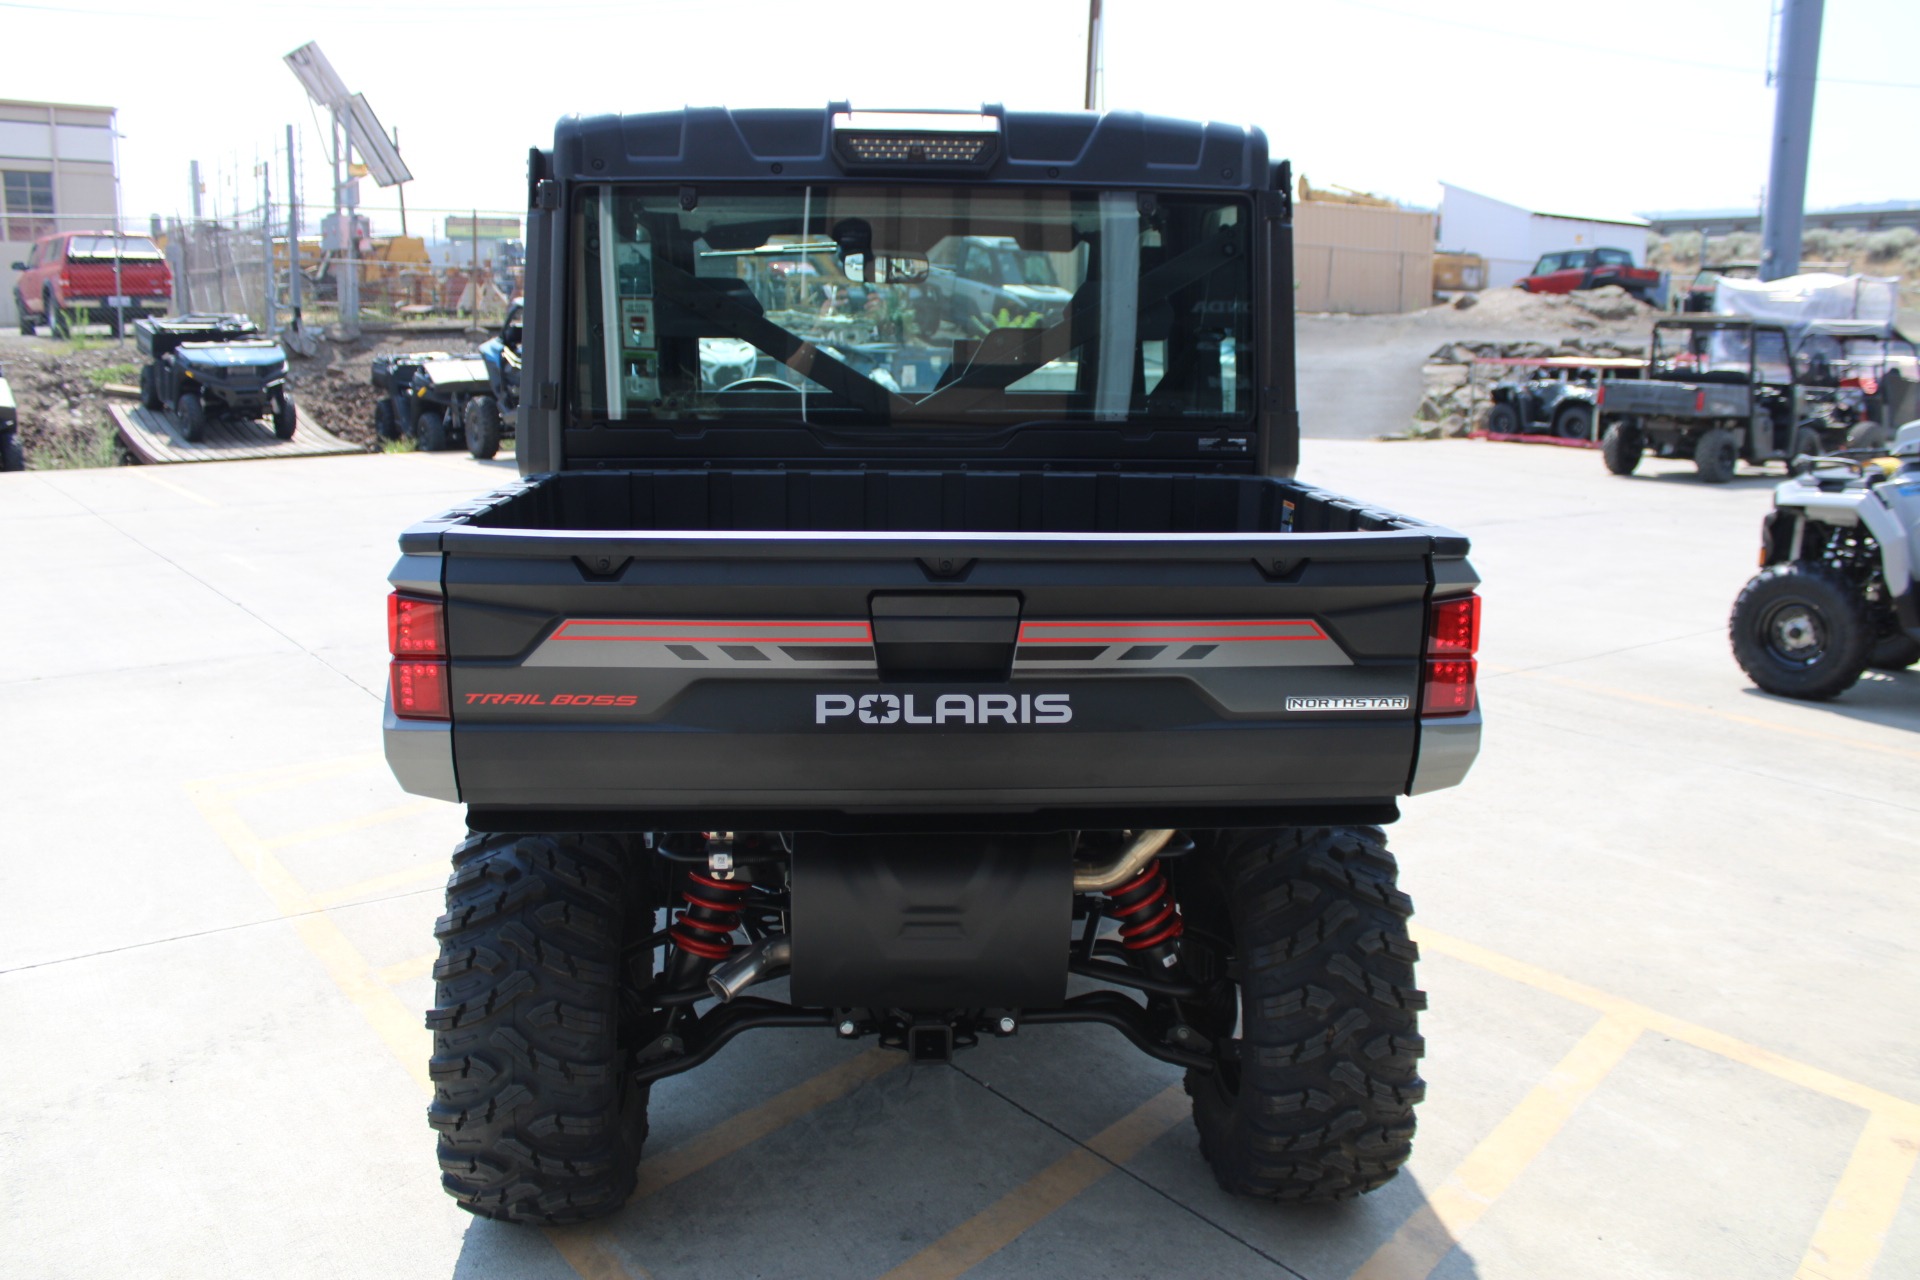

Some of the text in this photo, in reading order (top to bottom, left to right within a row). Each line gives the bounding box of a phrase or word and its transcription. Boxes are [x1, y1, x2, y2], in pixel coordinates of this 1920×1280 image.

[465, 693, 638, 706] TRAIL BOSS
[1291, 697, 1404, 708] NORTHSTAR
[815, 694, 1073, 724] POLARIS
